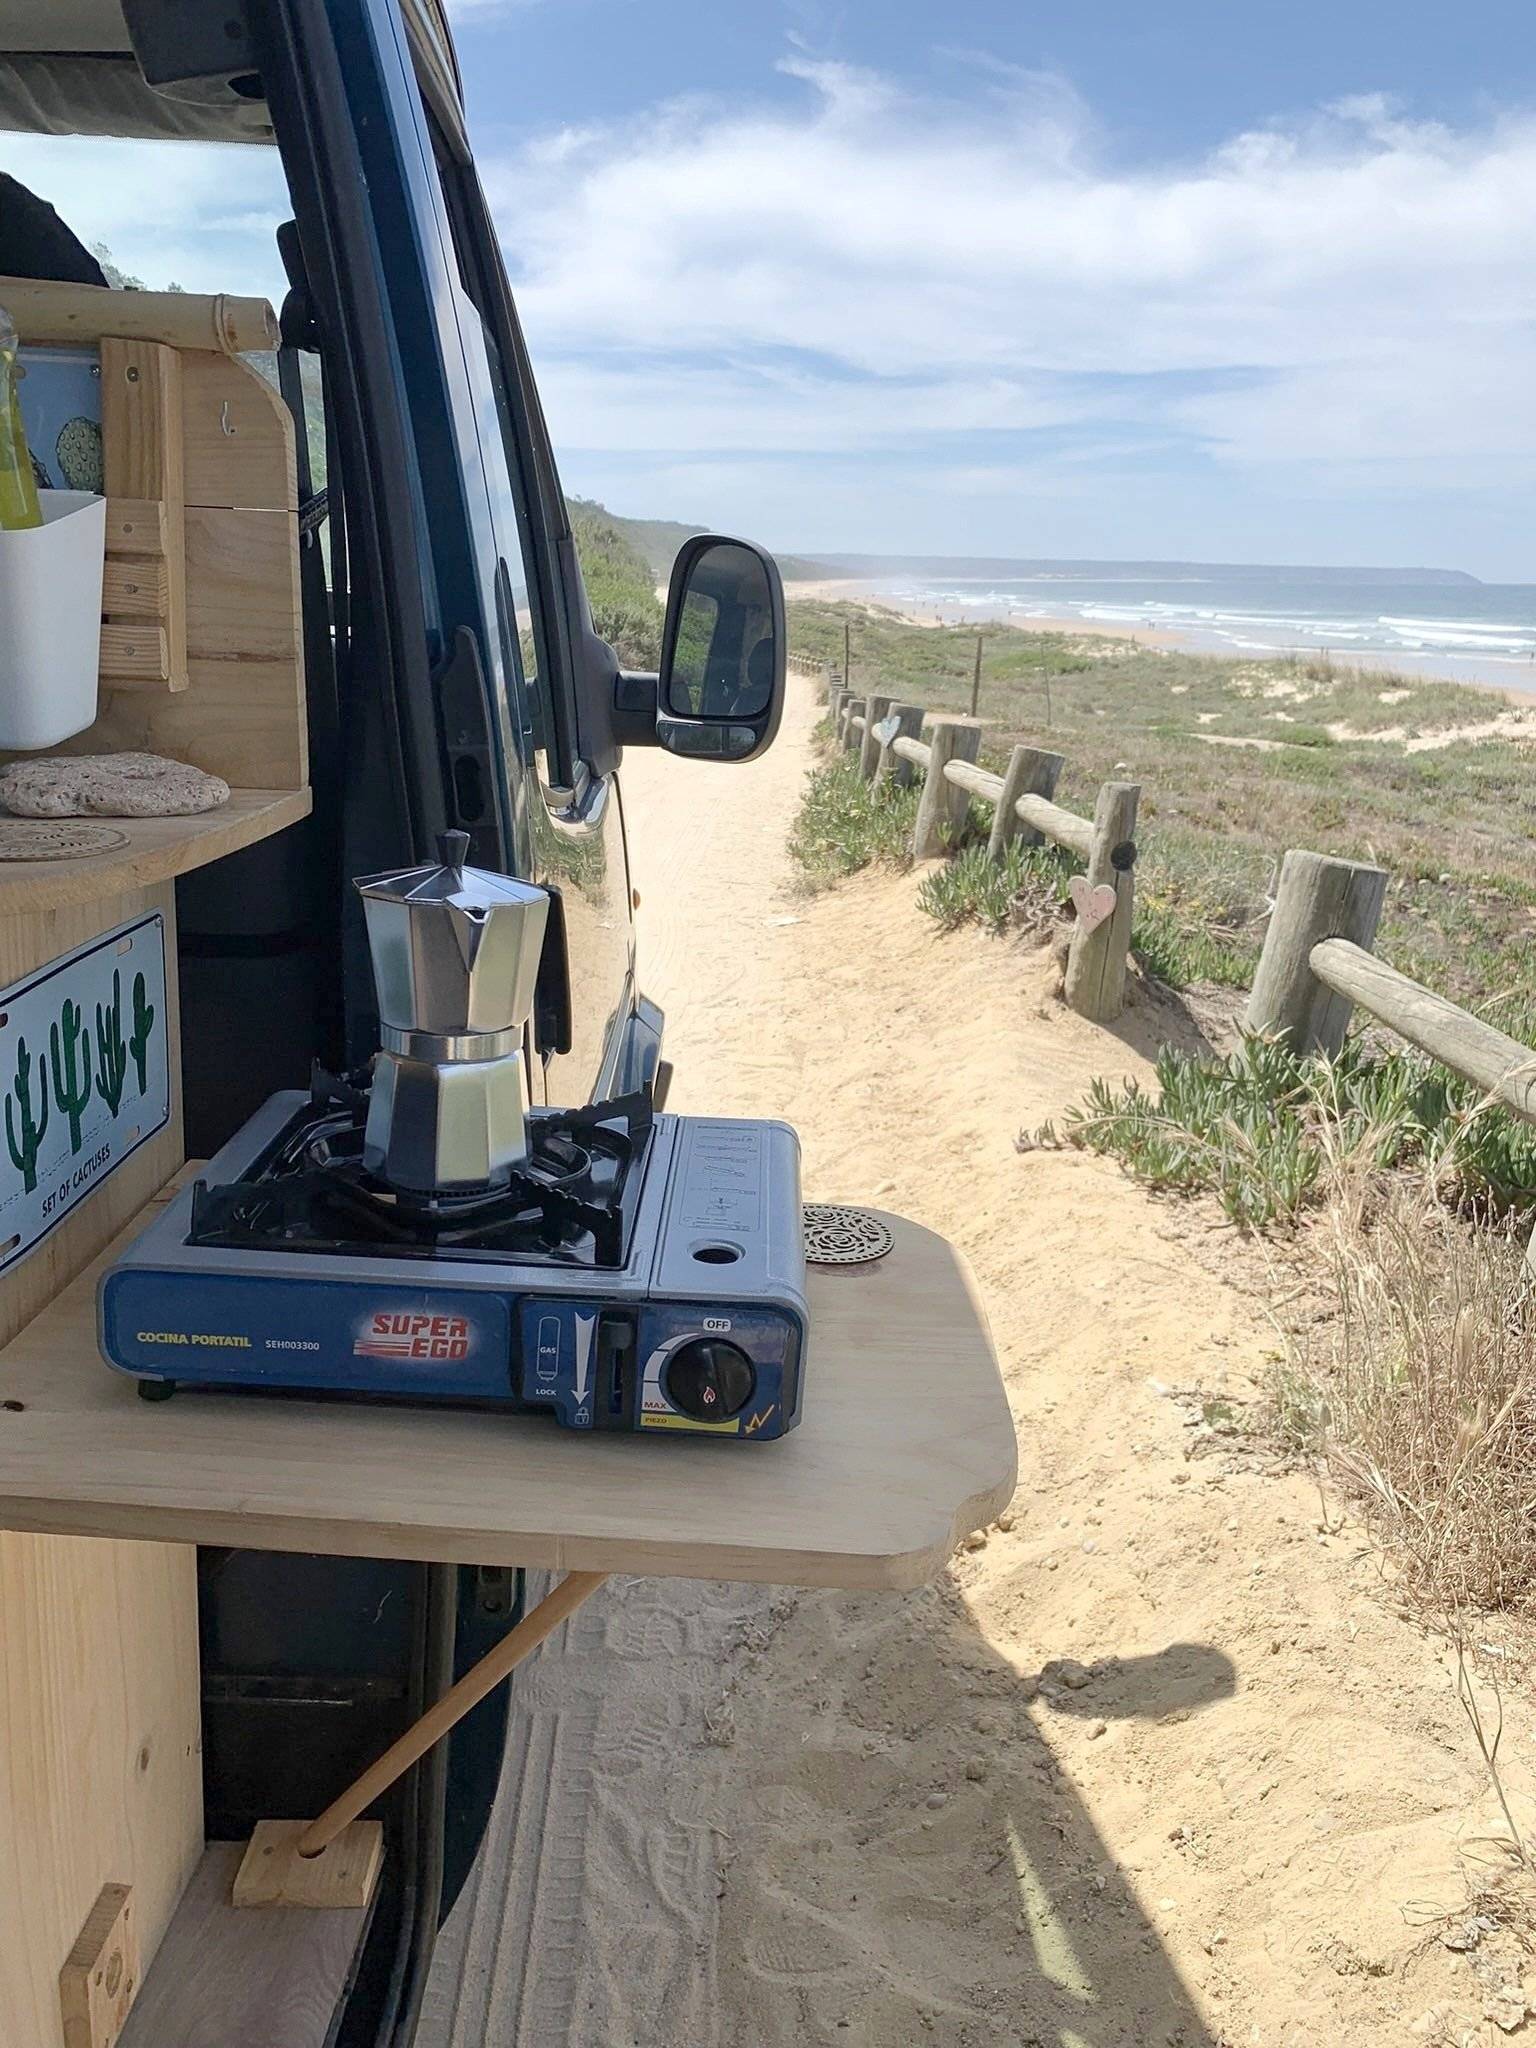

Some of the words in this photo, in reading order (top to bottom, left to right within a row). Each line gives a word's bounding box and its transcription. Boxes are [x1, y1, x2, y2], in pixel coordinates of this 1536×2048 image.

[42, 1191, 57, 1218] SET
[59, 1178, 71, 1201] OF
[73, 1142, 111, 1189] CACTUSES
[372, 1314, 468, 1336] SUPER
[707, 1319, 729, 1330] OFF
[137, 1332, 188, 1345] COCINA
[191, 1333, 252, 1348] PORTATIL
[265, 1339, 320, 1351] SEH003300
[410, 1338, 468, 1361] EGO
[540, 1346, 557, 1354] GAS
[535, 1388, 557, 1396] LOCK
[644, 1401, 667, 1409] MAX
